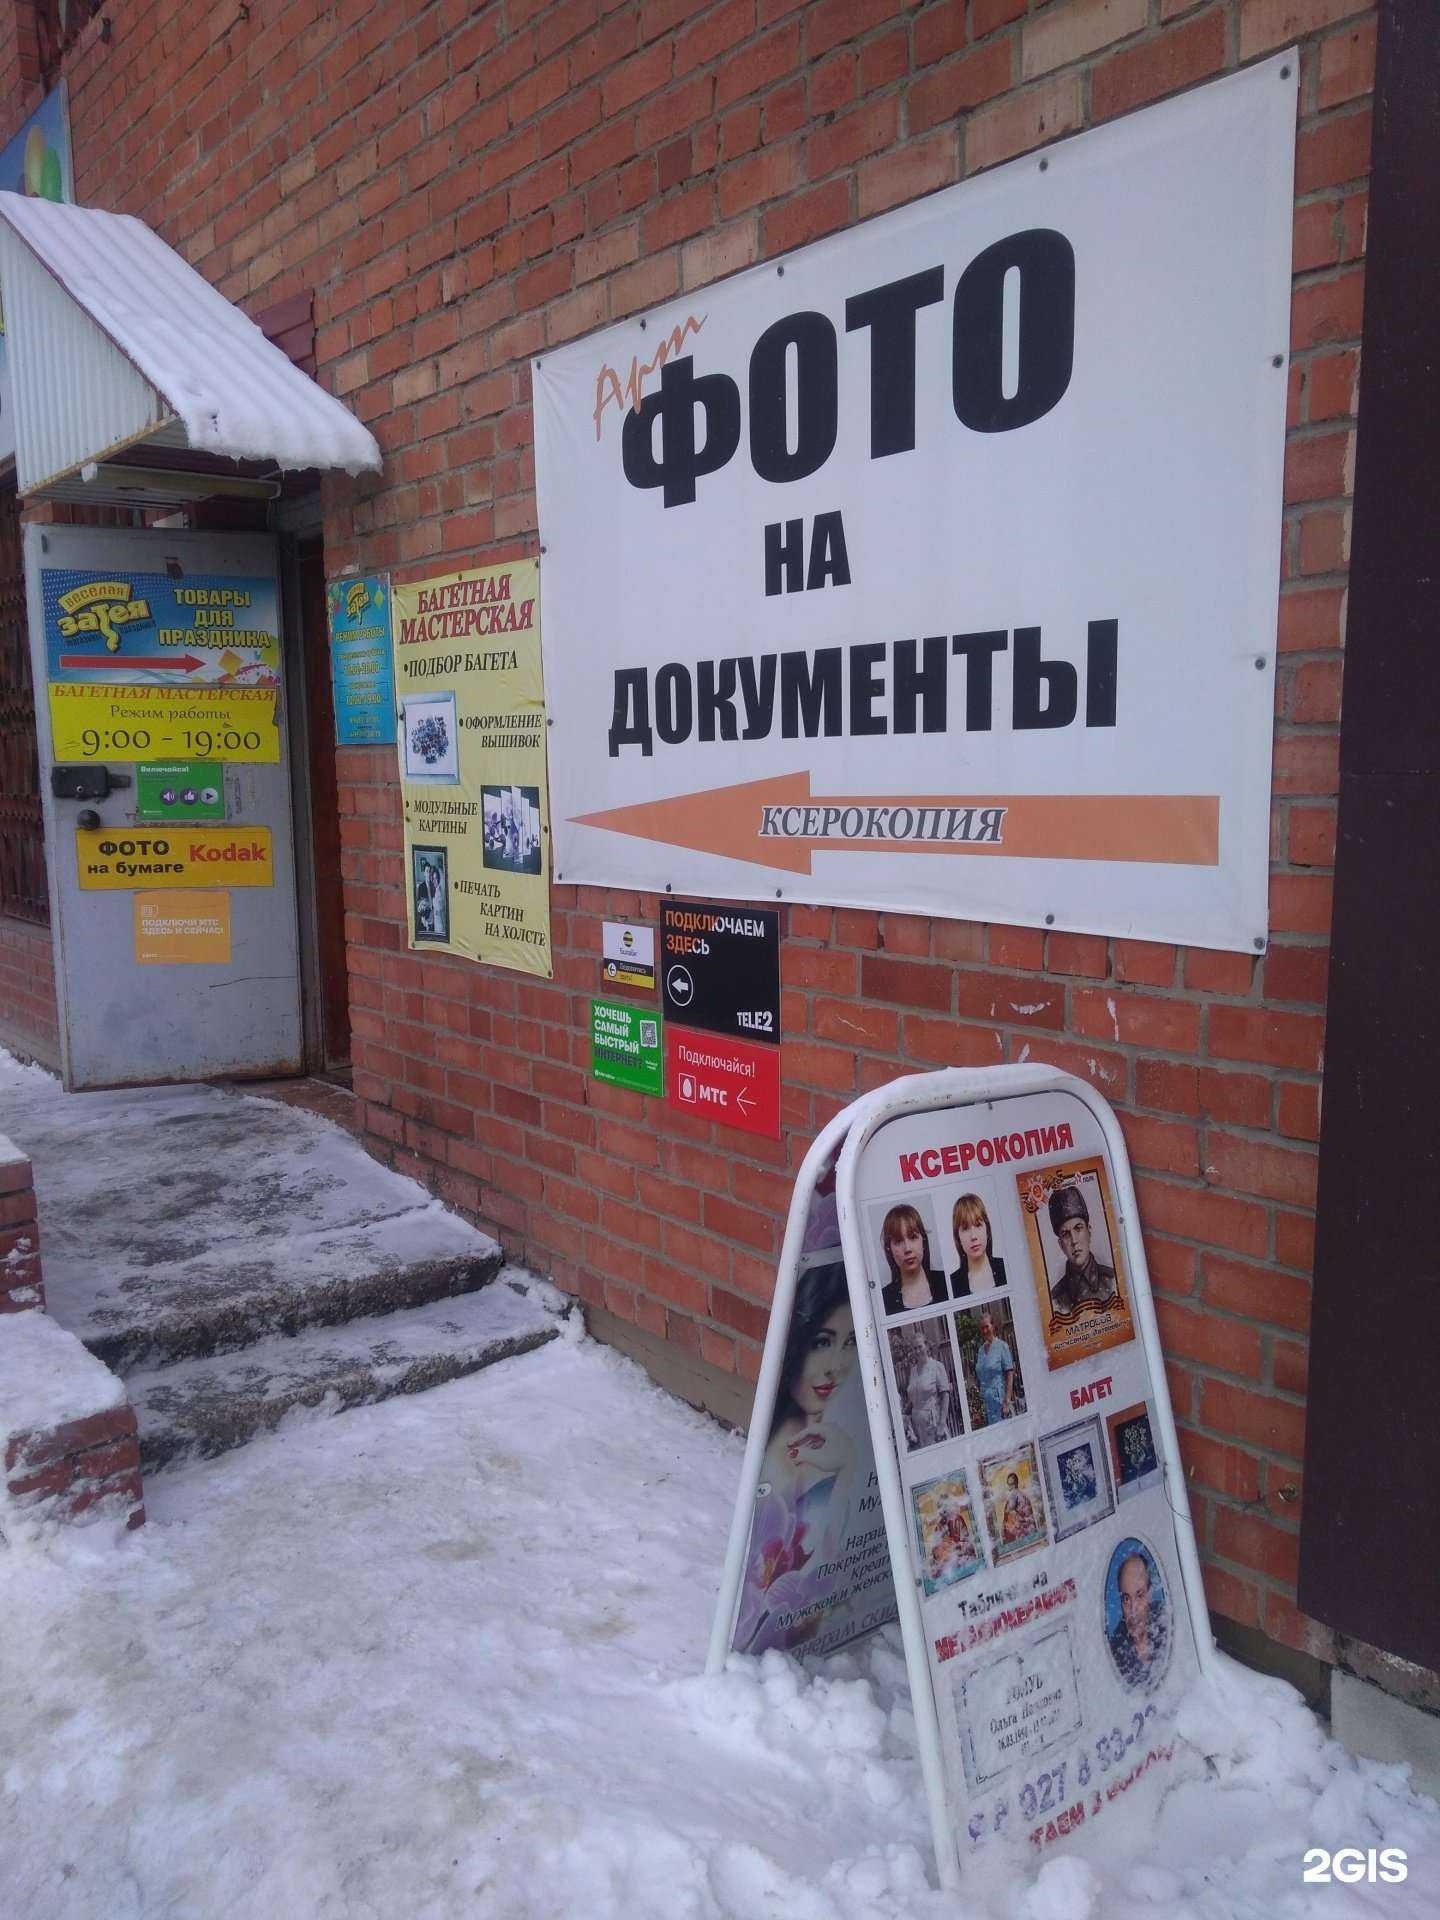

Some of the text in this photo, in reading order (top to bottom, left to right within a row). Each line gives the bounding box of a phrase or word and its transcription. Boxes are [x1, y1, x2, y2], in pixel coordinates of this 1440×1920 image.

[593, 312, 708, 442] Арт
[621, 228, 1075, 510] ФОТО
[765, 509, 852, 597] НА
[174, 588, 250, 607] ТОВАРЫ
[418, 574, 511, 615] БАГЕТНАЯ
[194, 609, 234, 628] ДЛЯ
[401, 600, 534, 645] МАСТЕРСКАЯ
[159, 629, 271, 648] ПРАЗДНИКА
[409, 654, 462, 678] ПОДБОР
[464, 650, 518, 673] БАГЕТА
[54, 685, 276, 701] БАГЕТНАЯ МАСТЕРСКАЯ
[608, 619, 1119, 757] ДОКУМЕНТЫ
[111, 705, 231, 722] Режим работы
[465, 714, 542, 731] ОФОРМЛЕНИЕ
[82, 729, 151, 756] 9:00
[183, 731, 261, 757] 19:00
[481, 734, 540, 749] ВЫШИВОК
[414, 801, 478, 816] МОДУЛЬНЫЕ
[419, 819, 467, 834] КАРТИНЫ
[759, 807, 1005, 843] КСЕРОКОПИЯ
[98, 840, 170, 856] ФОТО
[190, 843, 267, 863] Kodak
[88, 862, 184, 877] на бумаге
[460, 879, 501, 898] ПЕЧАТЬ
[480, 903, 524, 922] КАРТИН
[485, 920, 546, 947] НА ХОЛСТЕ
[665, 910, 765, 938] ПОДКЛЮЧАЕМ
[666, 933, 710, 955] ЗДЕСЬ
[594, 1005, 632, 1024] ХОЧЕШЬ
[737, 1010, 773, 1032] TELE2
[594, 1020, 629, 1038] САМЫЙ
[594, 1034, 639, 1054] БЫСТРЫЙ
[678, 1045, 755, 1078] Подключайся!
[699, 1085, 727, 1106] МТС
[899, 1122, 1074, 1182] КСЕРОКОПИЯ
[1070, 1377, 1112, 1409] БАГЕТ
[817, 1543, 881, 1579] Покрытие
[776, 1591, 839, 1631] Мужской
